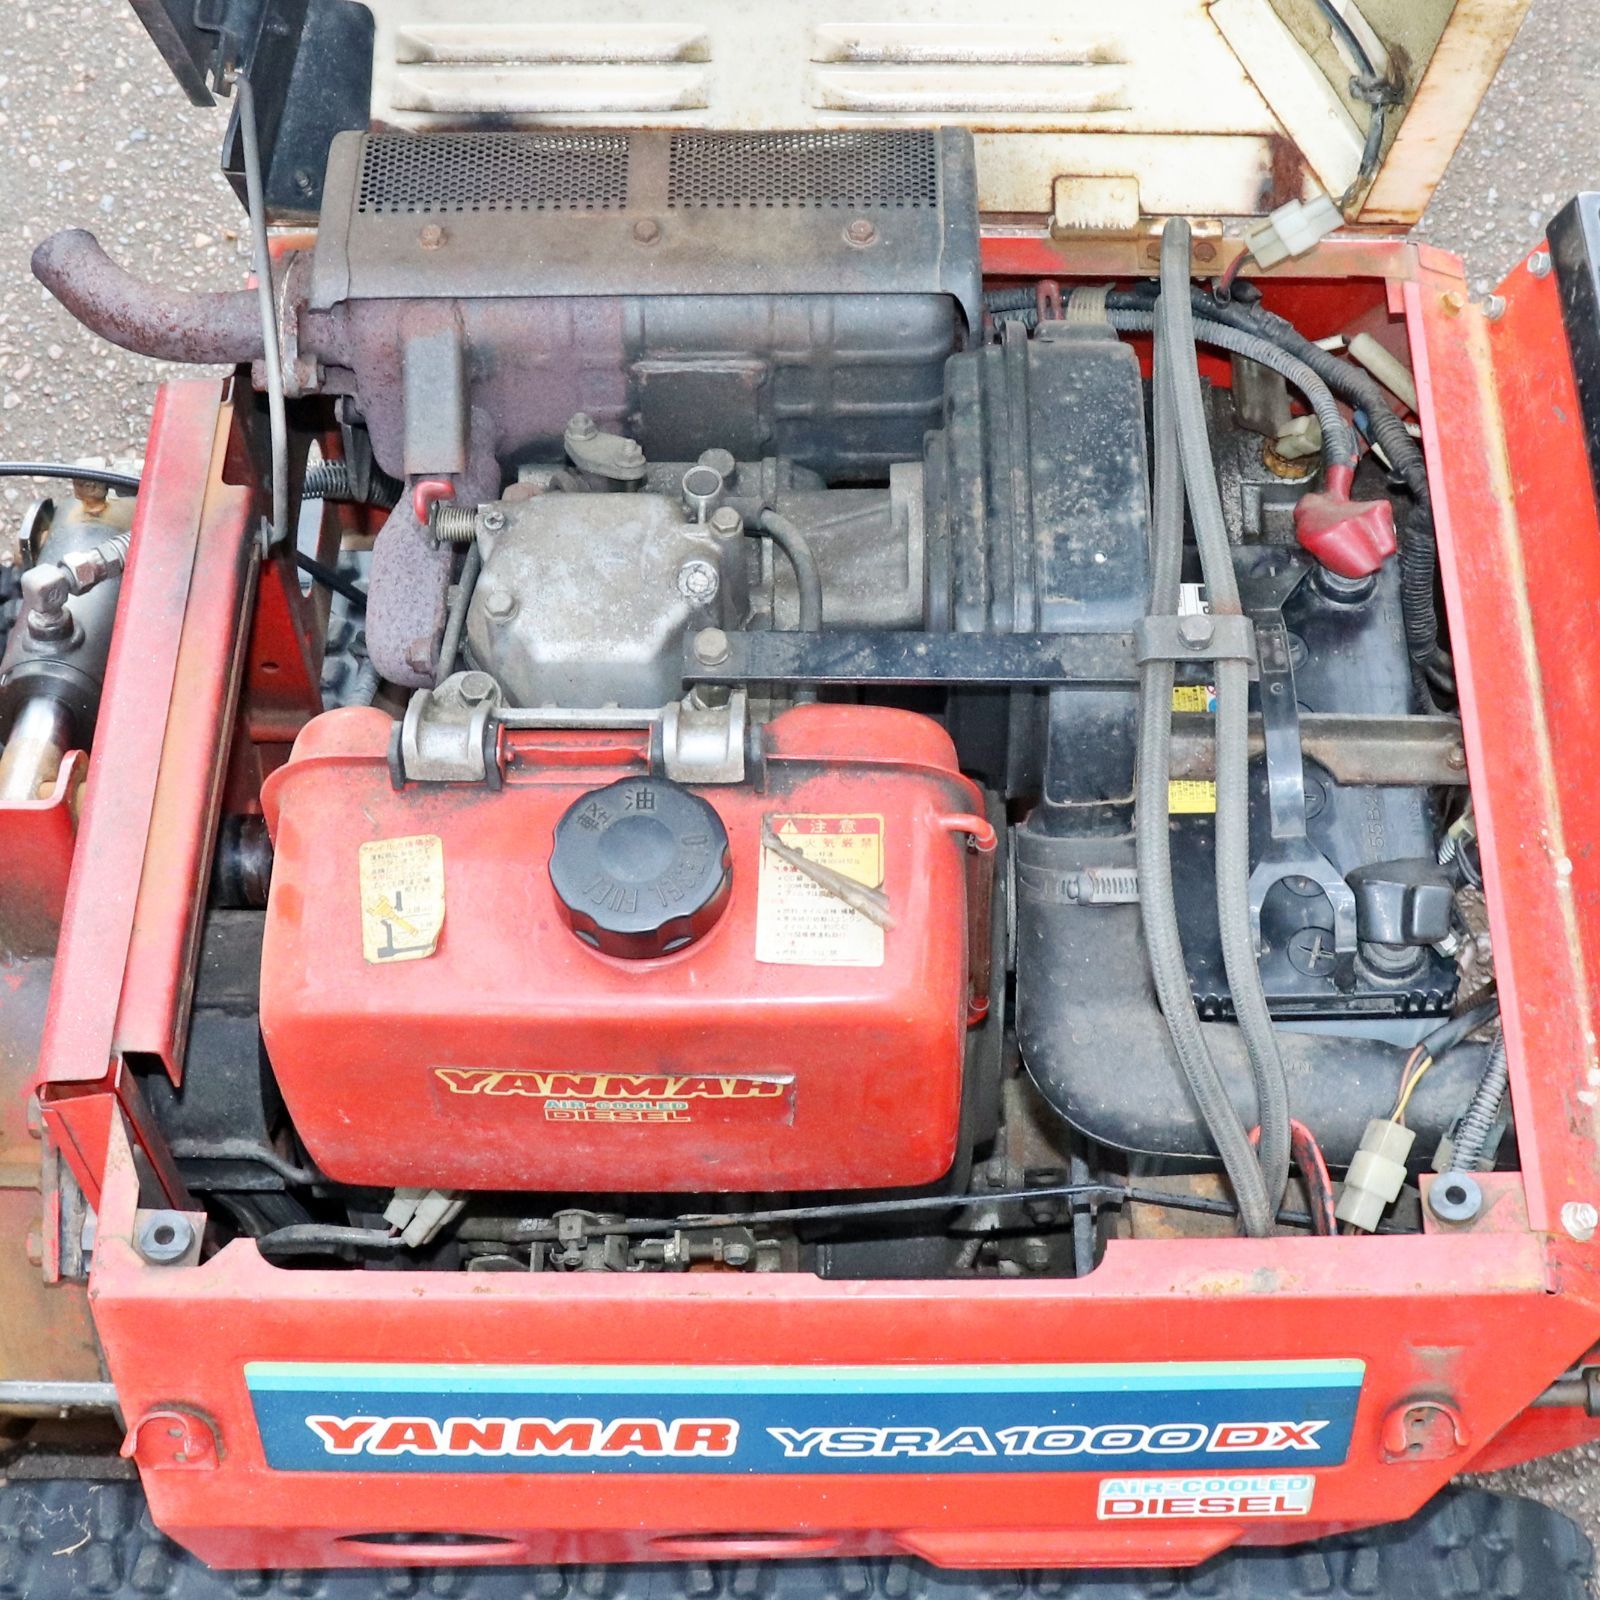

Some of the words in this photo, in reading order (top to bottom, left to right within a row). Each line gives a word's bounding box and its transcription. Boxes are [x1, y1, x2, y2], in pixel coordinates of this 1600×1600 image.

[810, 819, 857, 833] 注意
[434, 1069, 784, 1098] YANMAR
[544, 1100, 688, 1110] AIR-COOLED
[544, 1109, 691, 1122] DIESEL
[305, 1416, 740, 1457] YANMAR
[1105, 1477, 1308, 1494] AIR-COOLED
[1103, 1496, 1304, 1515] DIESEL
